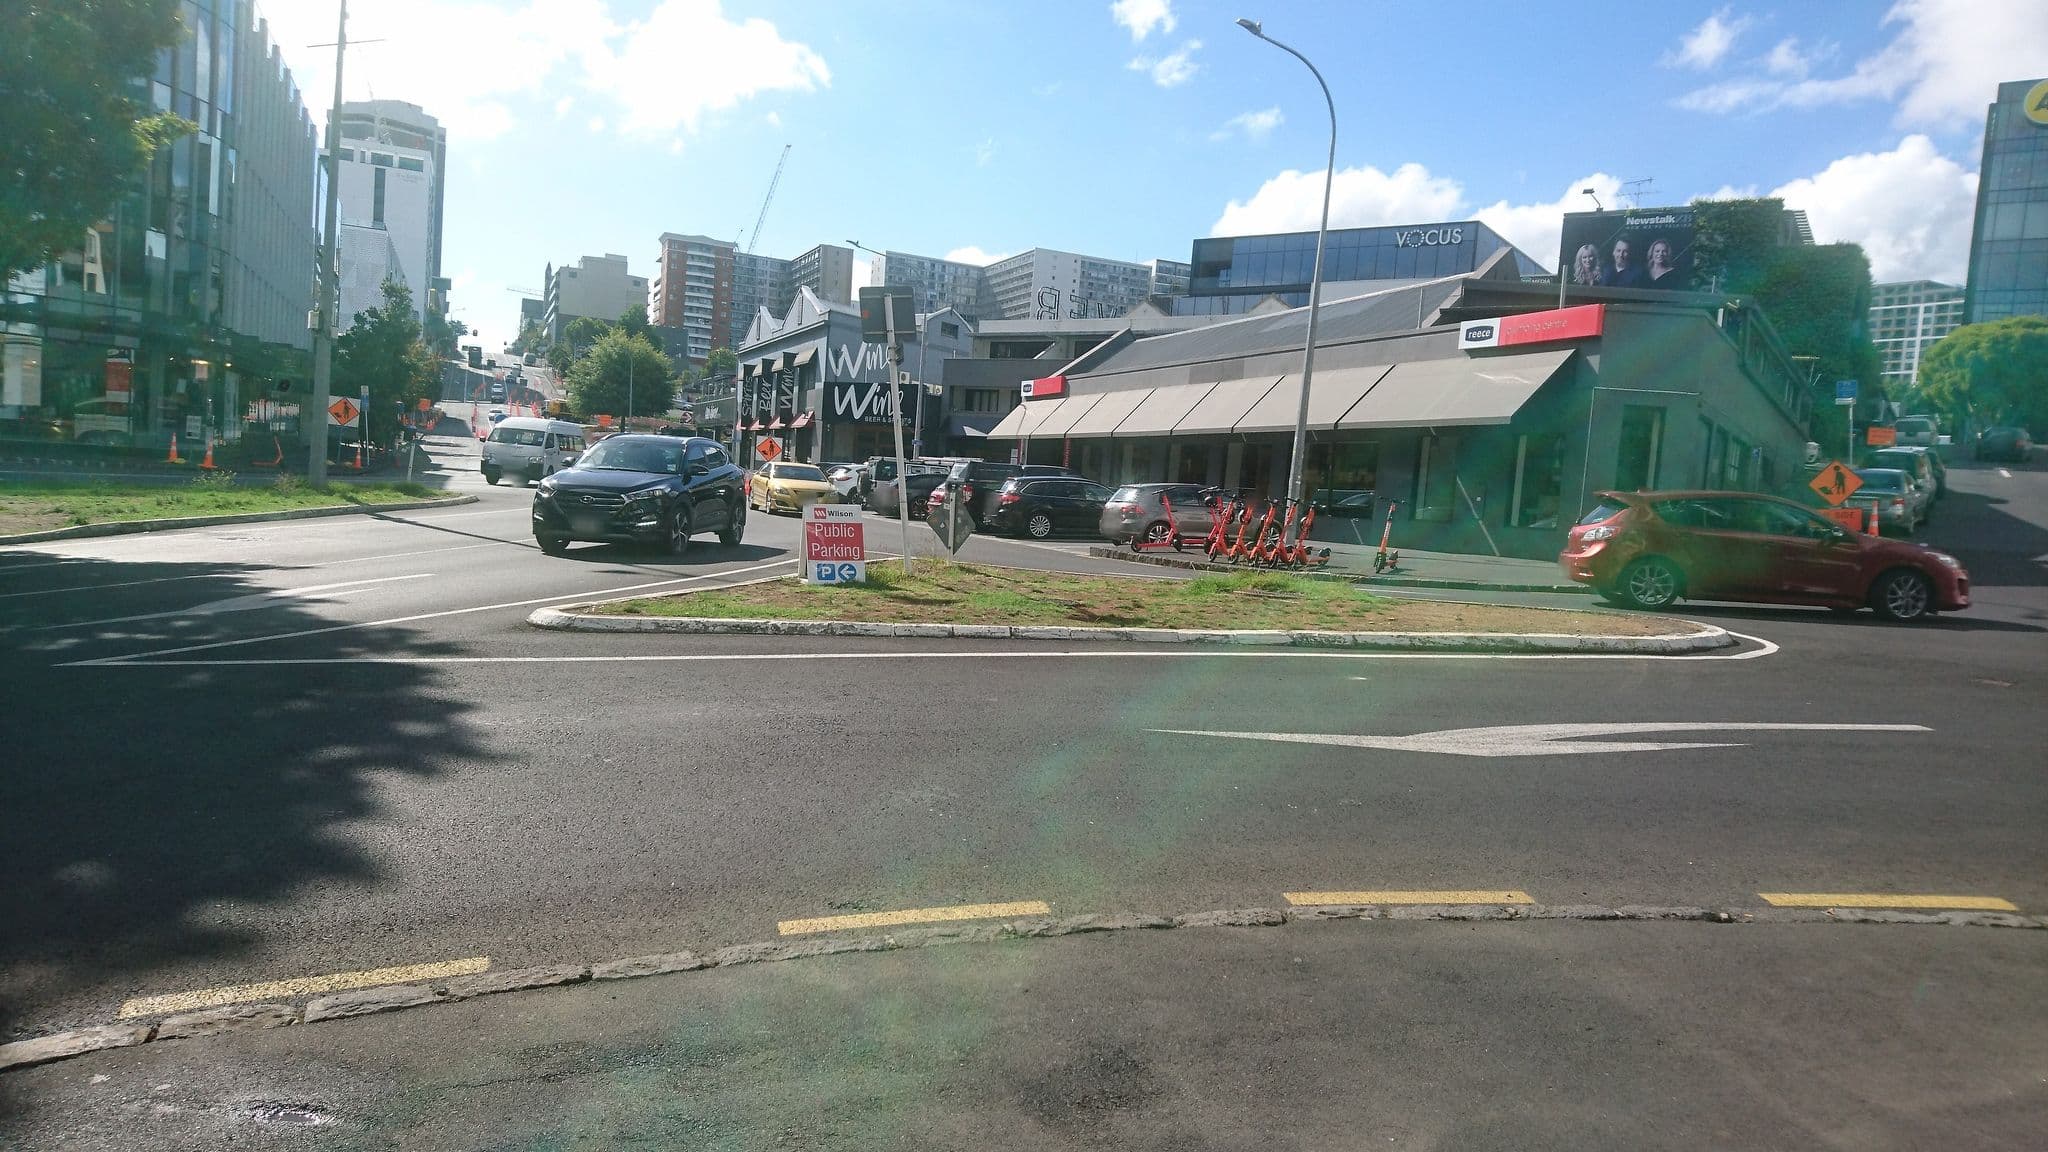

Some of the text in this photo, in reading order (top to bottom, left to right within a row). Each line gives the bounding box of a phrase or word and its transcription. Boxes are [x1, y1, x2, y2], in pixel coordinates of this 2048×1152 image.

[1626, 215, 1675, 225] Newstalk
[1396, 228, 1462, 248] VOCUS
[1467, 329, 1491, 338] reece
[760, 378, 772, 411] Beer
[780, 367, 794, 409] Wine
[815, 524, 855, 538] Public
[811, 543, 860, 560] Parking
